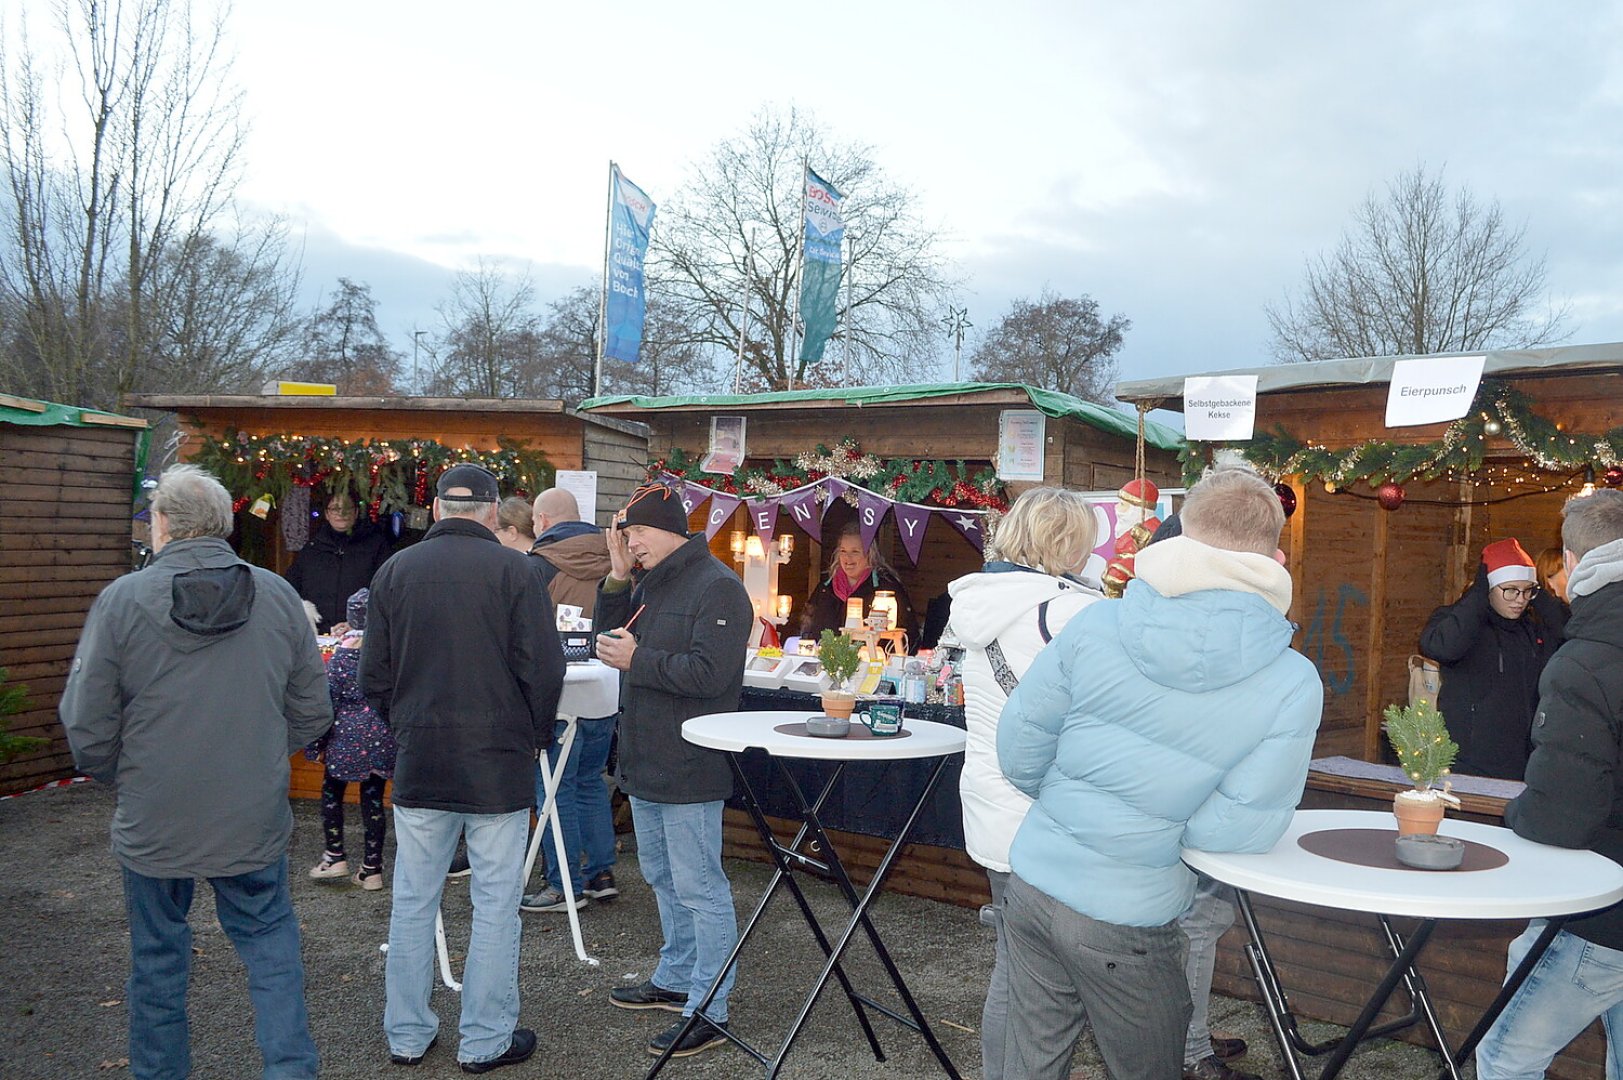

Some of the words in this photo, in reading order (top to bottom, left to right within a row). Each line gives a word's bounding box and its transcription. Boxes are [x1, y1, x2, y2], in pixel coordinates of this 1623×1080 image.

[808, 185, 836, 207] BOS
[1400, 384, 1467, 398] Eierpunsch
[1188, 399, 1252, 409] Selbstgebackene
[1208, 411, 1231, 419] Kekse
